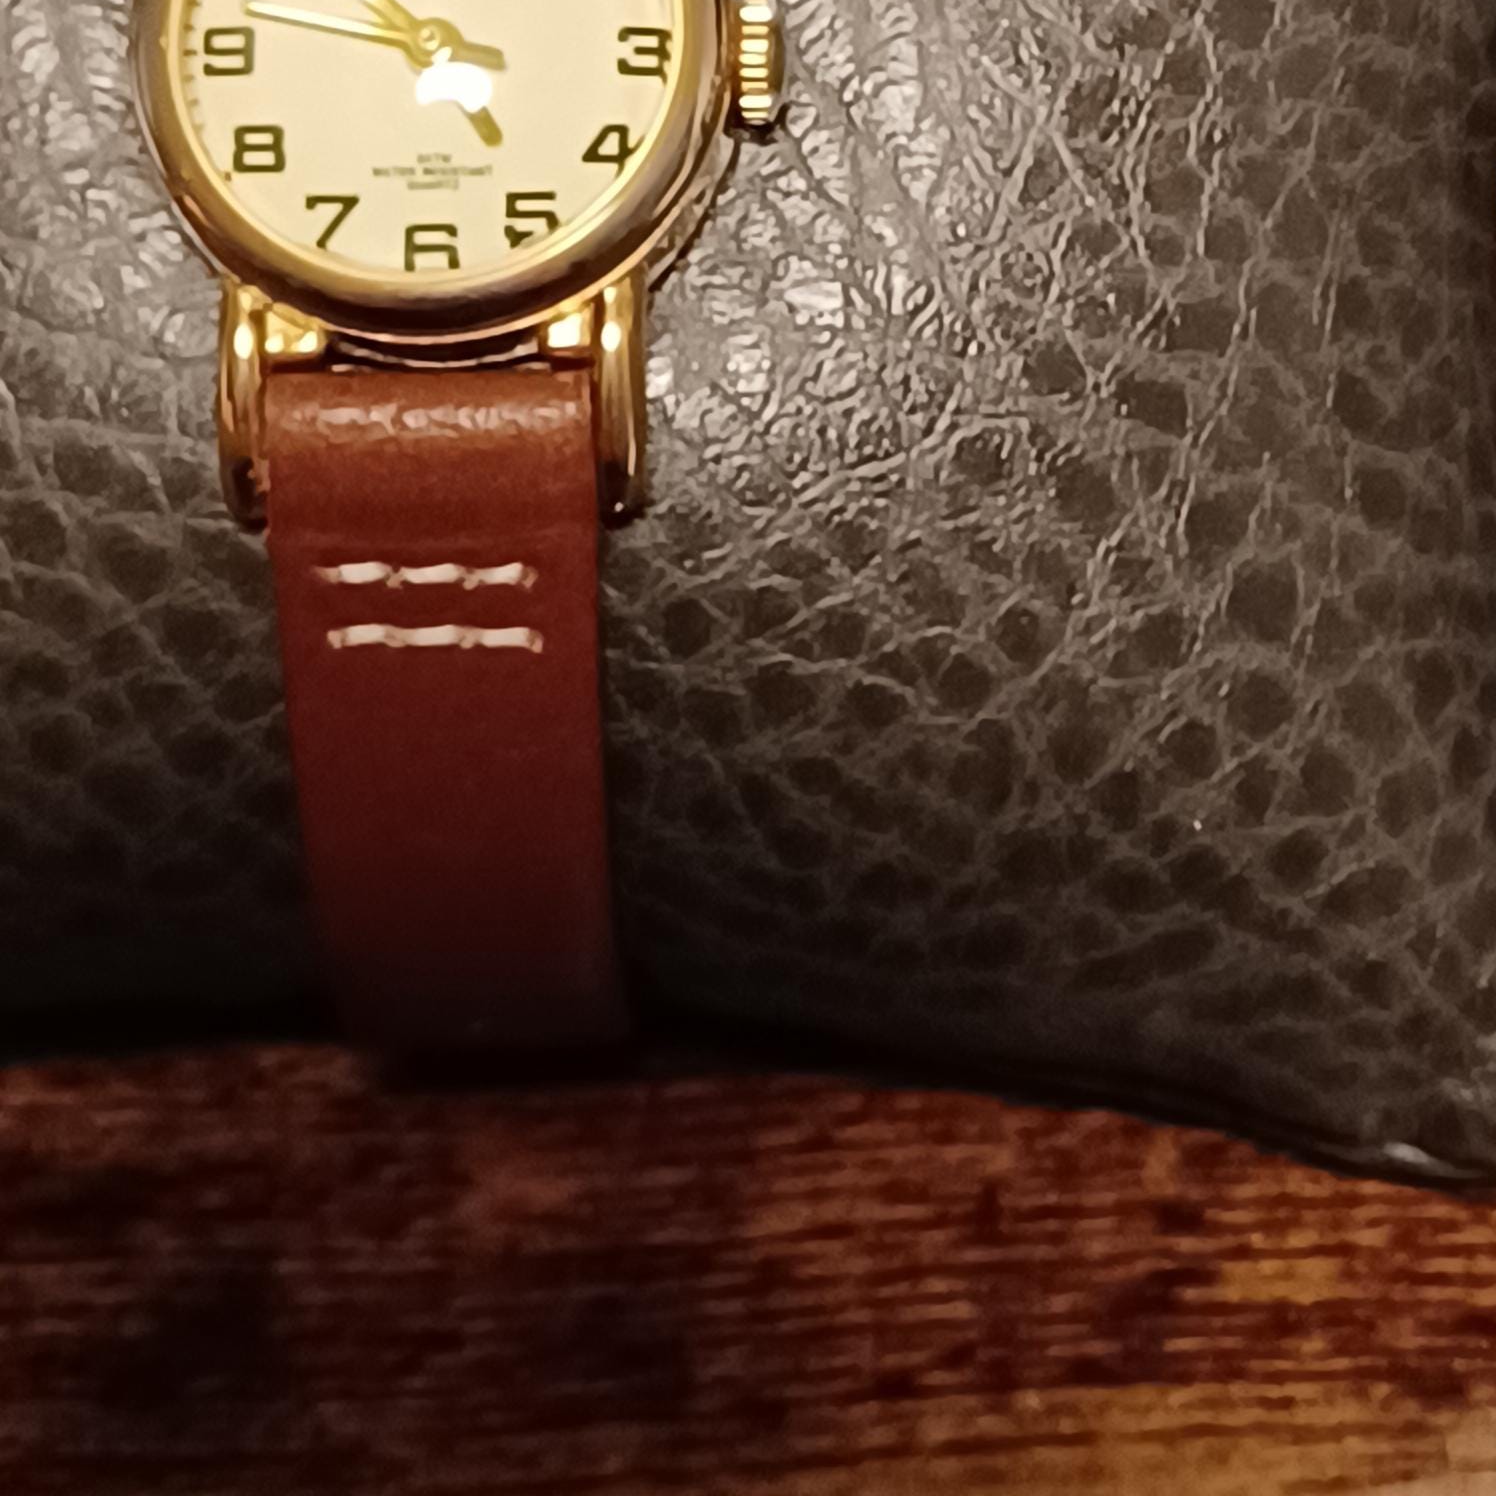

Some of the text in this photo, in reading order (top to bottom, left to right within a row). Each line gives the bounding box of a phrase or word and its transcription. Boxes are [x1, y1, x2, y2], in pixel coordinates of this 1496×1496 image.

[203, 26, 255, 77] 9
[617, 26, 672, 78] 3
[232, 124, 286, 173] 8
[581, 124, 646, 178] 4
[304, 194, 360, 250] 7
[503, 191, 561, 248] 5
[403, 224, 461, 273] 6
